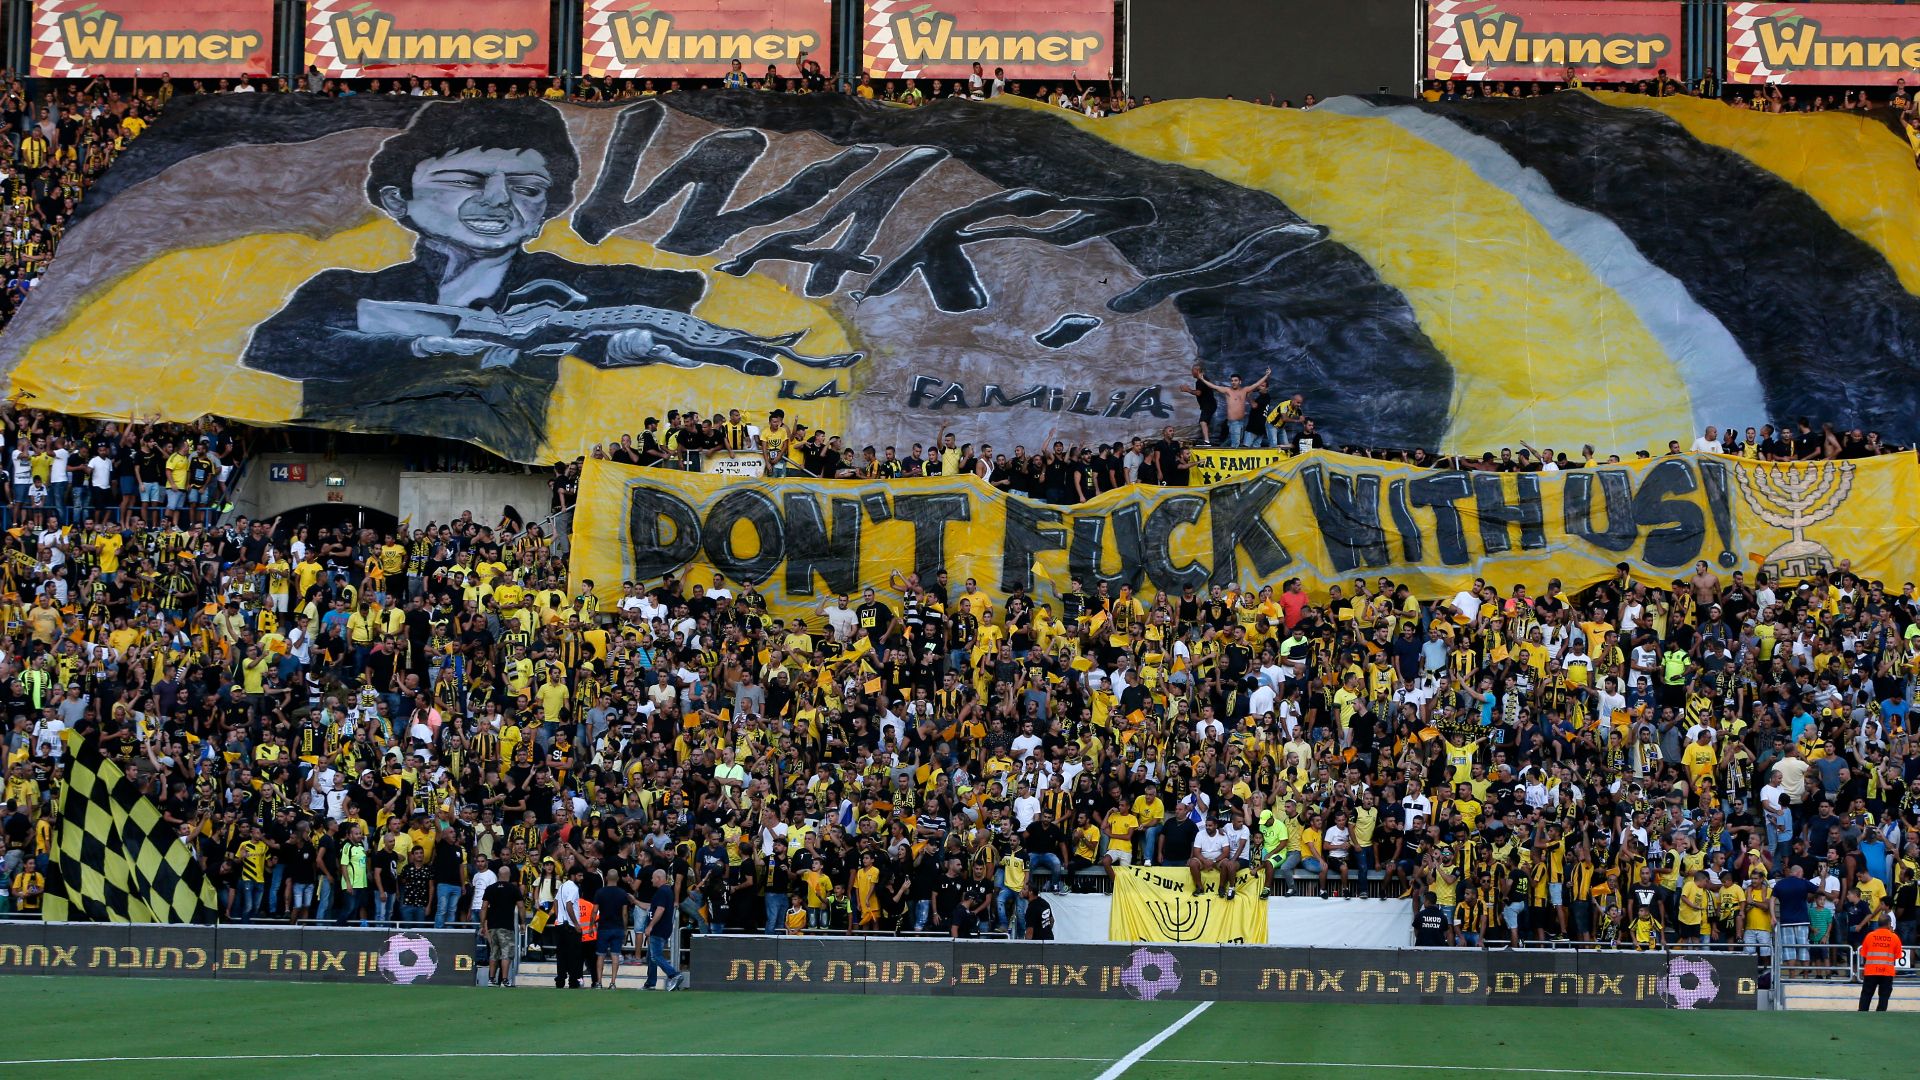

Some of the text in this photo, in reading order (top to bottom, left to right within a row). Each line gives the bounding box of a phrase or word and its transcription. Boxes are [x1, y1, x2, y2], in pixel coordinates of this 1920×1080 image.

[63, 16, 258, 60] Winner
[335, 17, 532, 60] Winner
[895, 17, 1099, 62] Winner
[1459, 18, 1666, 64] Winner
[777, 379, 845, 400] LA
[271, 466, 289, 479] 14
[631, 454, 1738, 597] DON'T FUCK WITH US!
[88, 946, 207, 969] כתובת
[725, 959, 813, 982] אחת
[822, 960, 946, 984] כתובת
[1257, 968, 1346, 992] אחת
